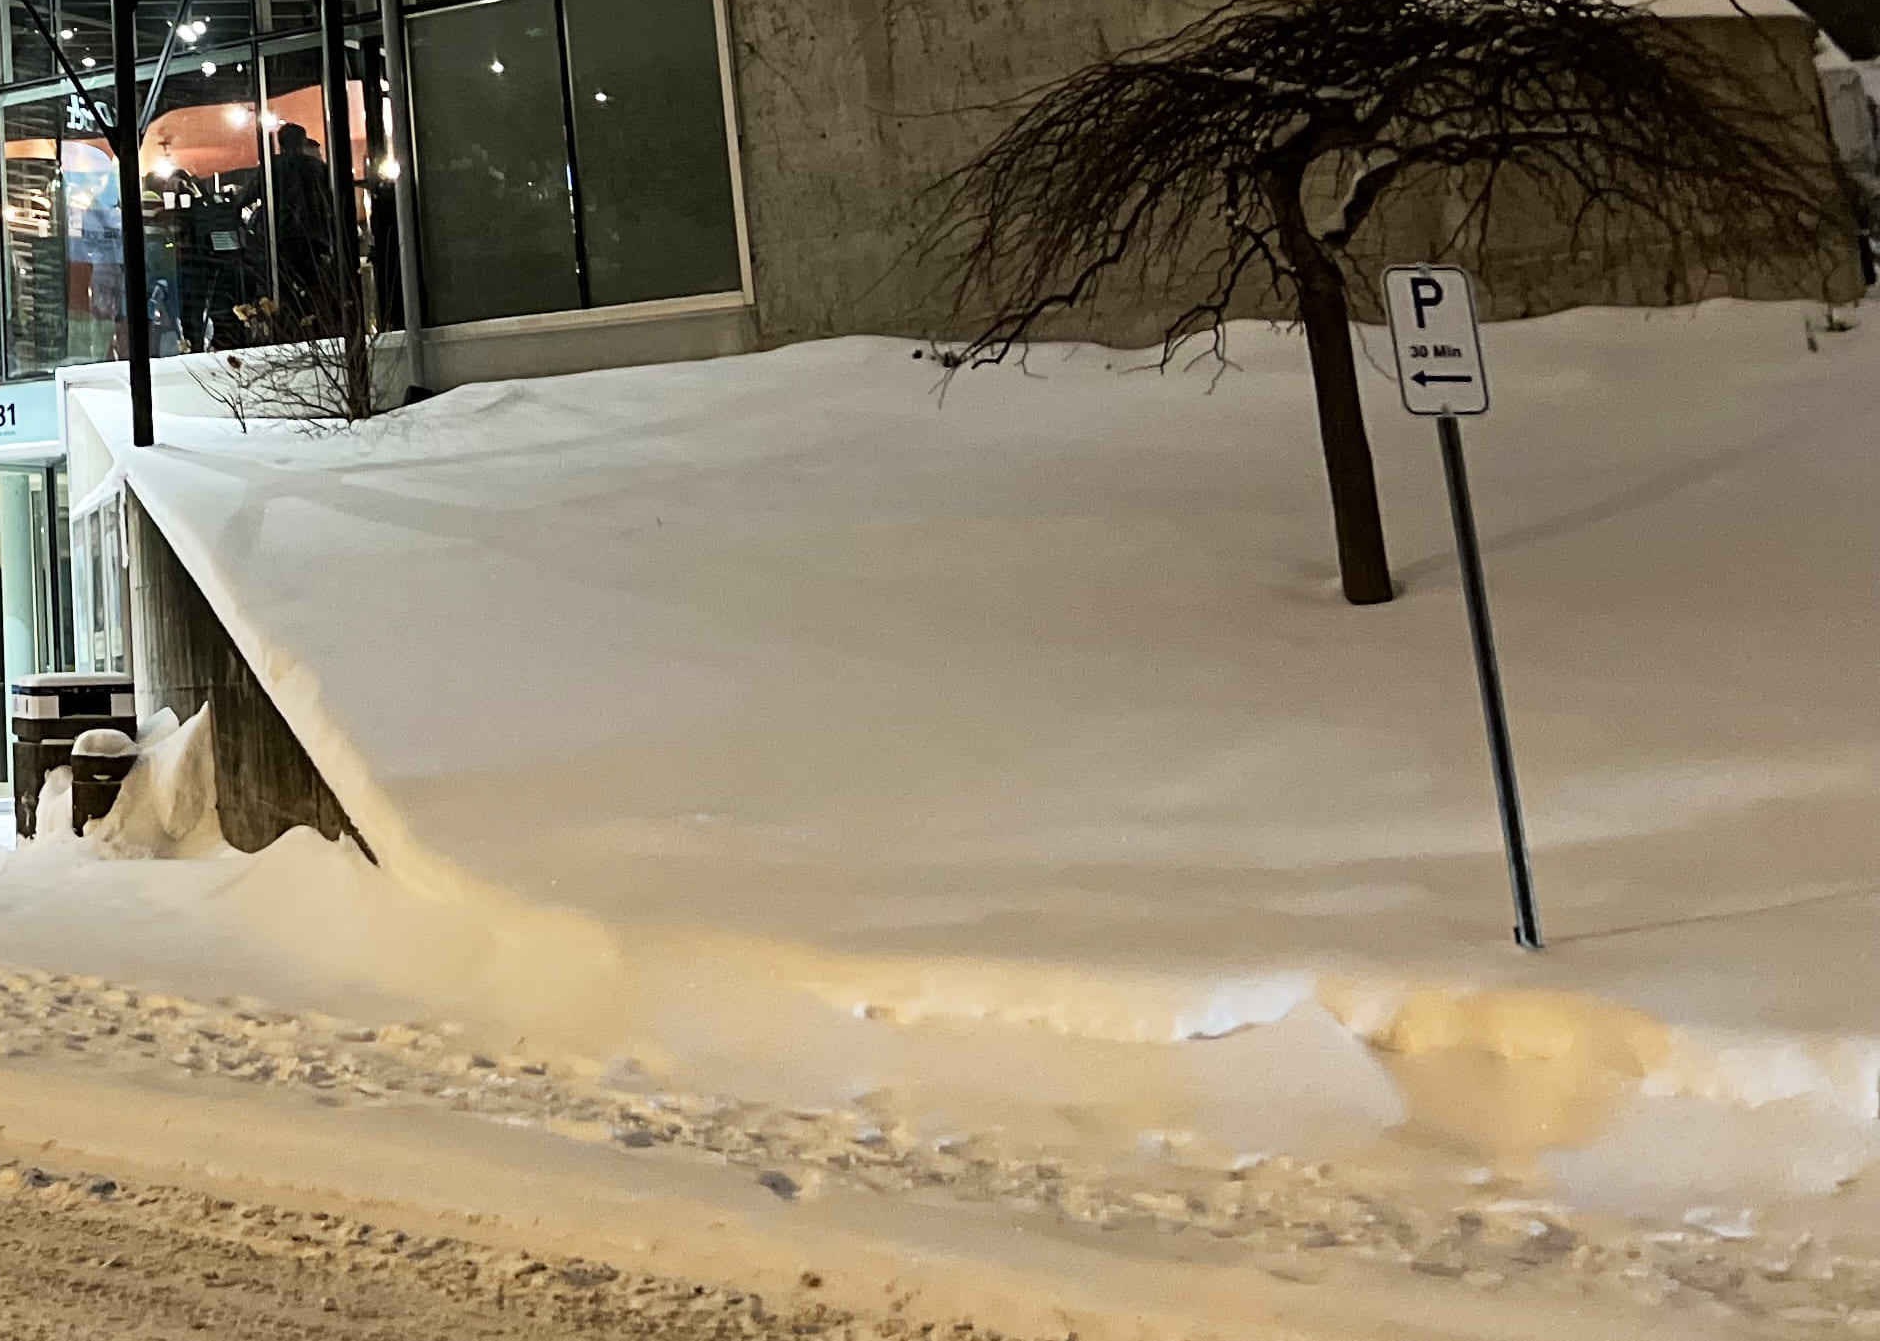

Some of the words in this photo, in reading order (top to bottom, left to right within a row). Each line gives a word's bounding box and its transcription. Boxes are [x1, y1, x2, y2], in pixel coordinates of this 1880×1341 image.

[1410, 278, 1443, 329] P
[1409, 345, 1428, 358] 30
[1433, 345, 1462, 358] Min
